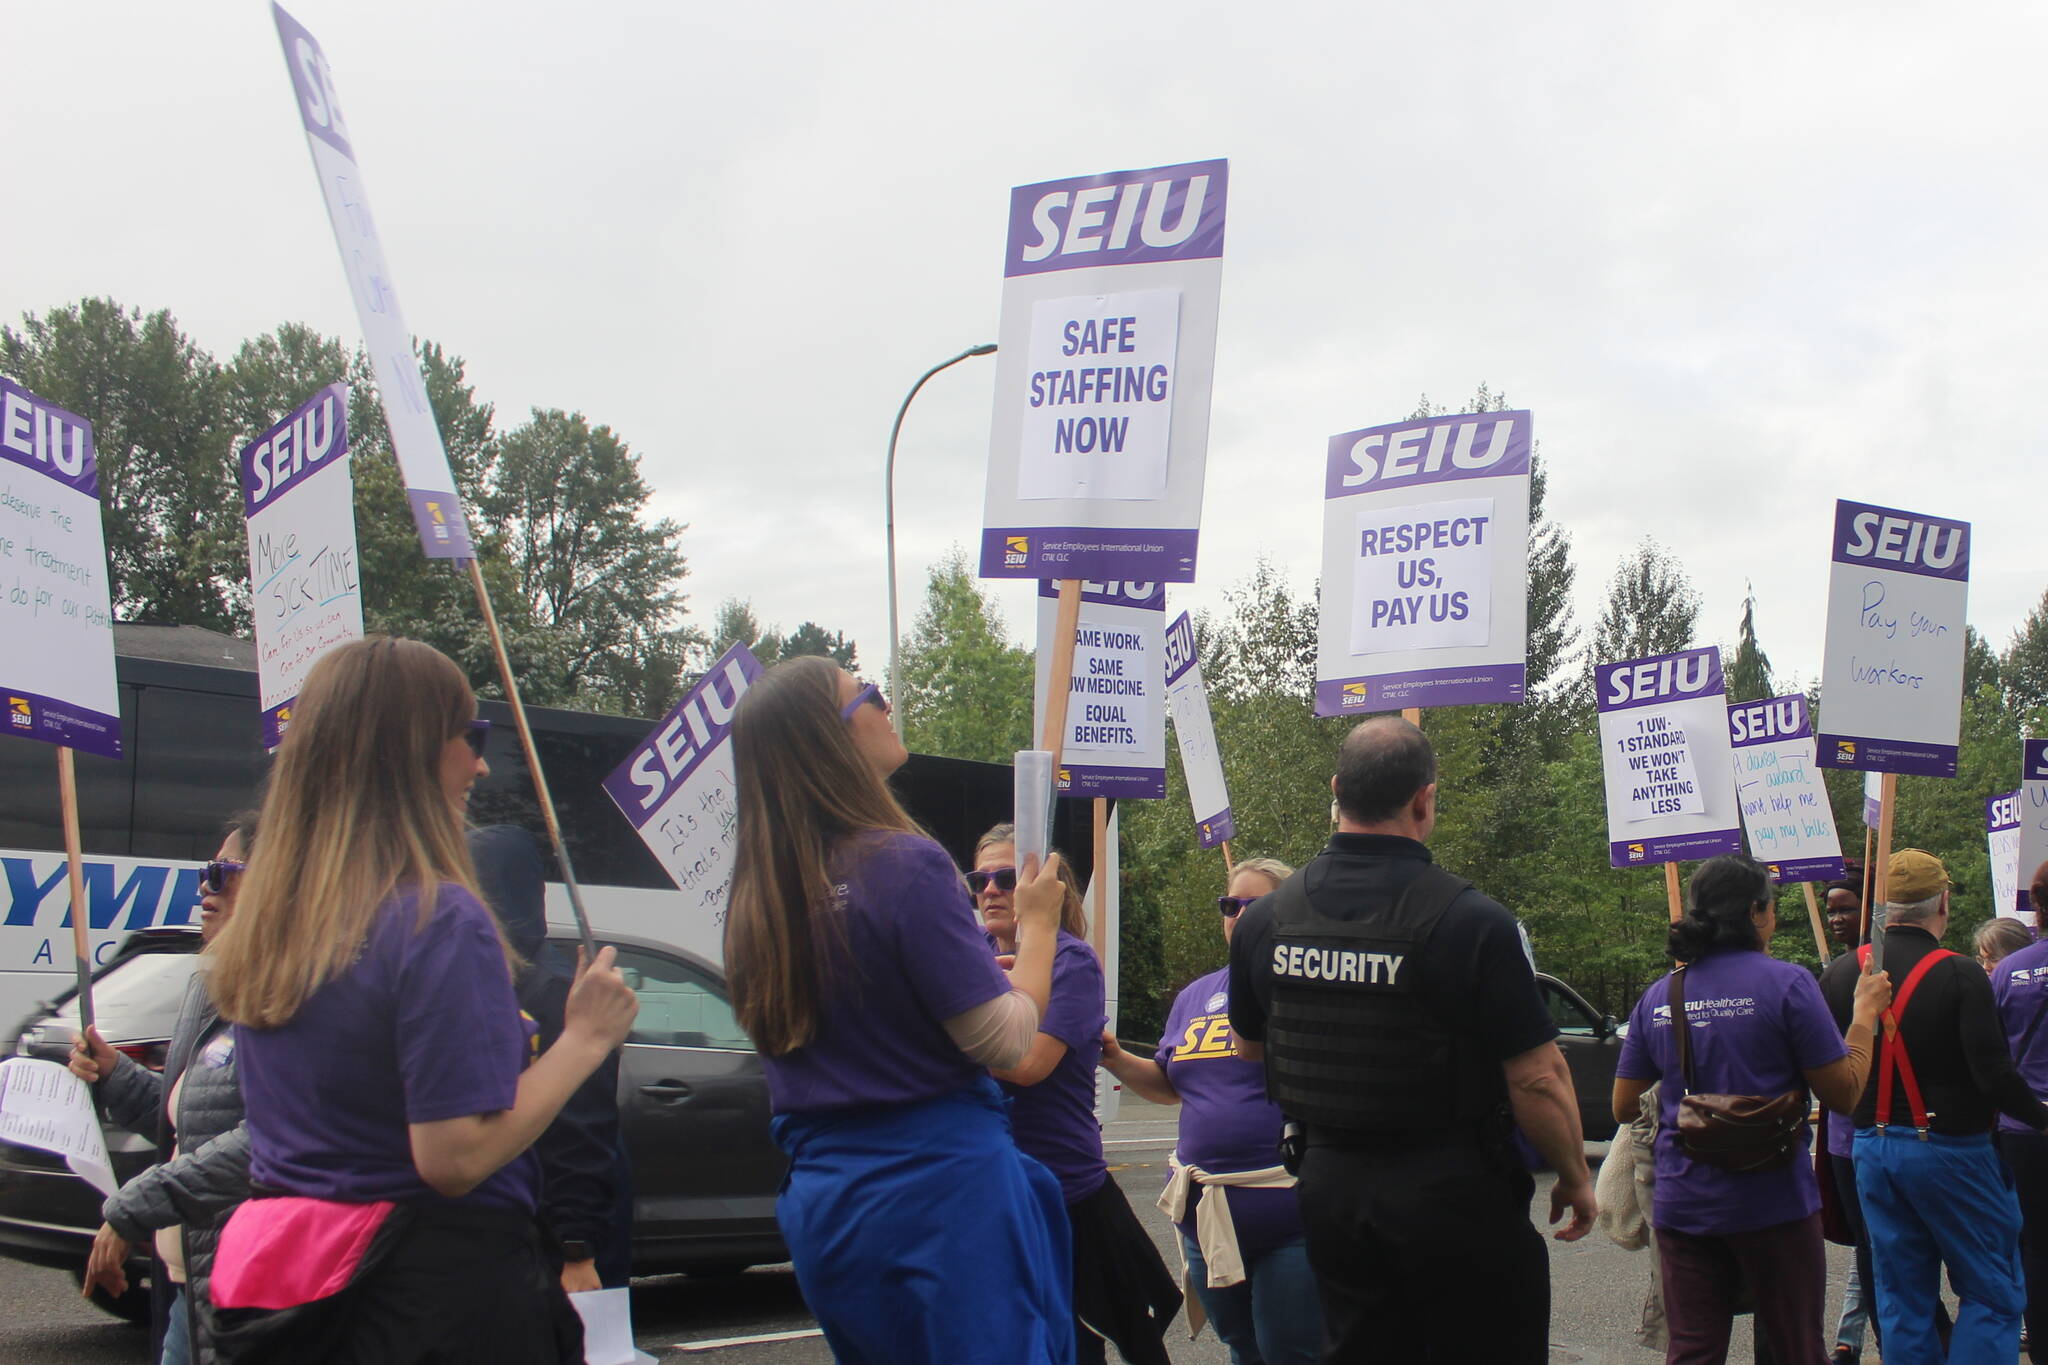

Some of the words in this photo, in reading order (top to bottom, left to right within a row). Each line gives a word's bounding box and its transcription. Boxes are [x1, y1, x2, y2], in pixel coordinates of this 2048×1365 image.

[1022, 175, 1210, 262] SEIU
[1062, 316, 1136, 357] SAFE
[1030, 364, 1168, 408] STAFFING
[3, 391, 84, 478] EIU
[253, 395, 334, 504] SEIU
[1055, 416, 1129, 453] NOW
[1342, 420, 1514, 487] SEIU
[50, 503, 73, 533] the
[1360, 516, 1489, 557] RESPECT
[1846, 511, 1962, 569] SEIU
[25, 536, 92, 588] treatment
[258, 532, 299, 576] More
[1004, 554, 1027, 564] SEIU
[273, 577, 314, 618] SICK
[309, 545, 358, 601] TIME
[1397, 558, 1442, 589] US,
[10, 576, 28, 605] do
[35, 586, 53, 619] for
[62, 599, 78, 619] our
[1371, 596, 1424, 628] PAY
[1429, 591, 1469, 622] US
[1861, 580, 1897, 639] Pay
[1075, 629, 1101, 648] AME
[1103, 631, 1144, 651] WORK.
[1165, 619, 1192, 679] SEIU
[1089, 657, 1124, 676] SAME
[1473, 676, 1494, 684] Union
[1609, 654, 1710, 705] SEIU
[1087, 677, 1146, 696] MEDICINE.
[1342, 694, 1366, 705] SEIU
[12, 713, 32, 726] SEIU
[1086, 704, 1127, 723] EQUAL
[1637, 720, 1645, 734] 1
[1731, 700, 1800, 743] SEIU
[630, 658, 749, 811] SEIU
[1075, 725, 1137, 745] BENEFITS.
[1618, 739, 1626, 753] 1
[1627, 730, 1687, 753] STANDARD
[1629, 755, 1649, 770] WE
[1650, 750, 1686, 768] WON'T
[1733, 752, 1743, 775] A
[1836, 752, 1855, 761] SEIU
[1632, 781, 1694, 801] ANYTHING
[1646, 767, 1678, 784] TAKE
[1651, 798, 1682, 815] LESS
[1770, 791, 1792, 817] help
[1798, 792, 1818, 807] me
[1991, 795, 2022, 828] SEIU
[660, 812, 698, 855] It's
[698, 787, 727, 815] the
[1755, 827, 1778, 850] pay
[1780, 824, 1800, 848] my
[1801, 818, 1830, 838] bills
[678, 846, 721, 891] that's
[1629, 852, 1644, 860] SEIU
[1272, 944, 1404, 985] SECURITY
[1684, 997, 1756, 1012] EIUHealthcare.
[1711, 1007, 1735, 1019] Quality
[1736, 1006, 1755, 1016] Care
[1175, 1018, 1236, 1055] SE
